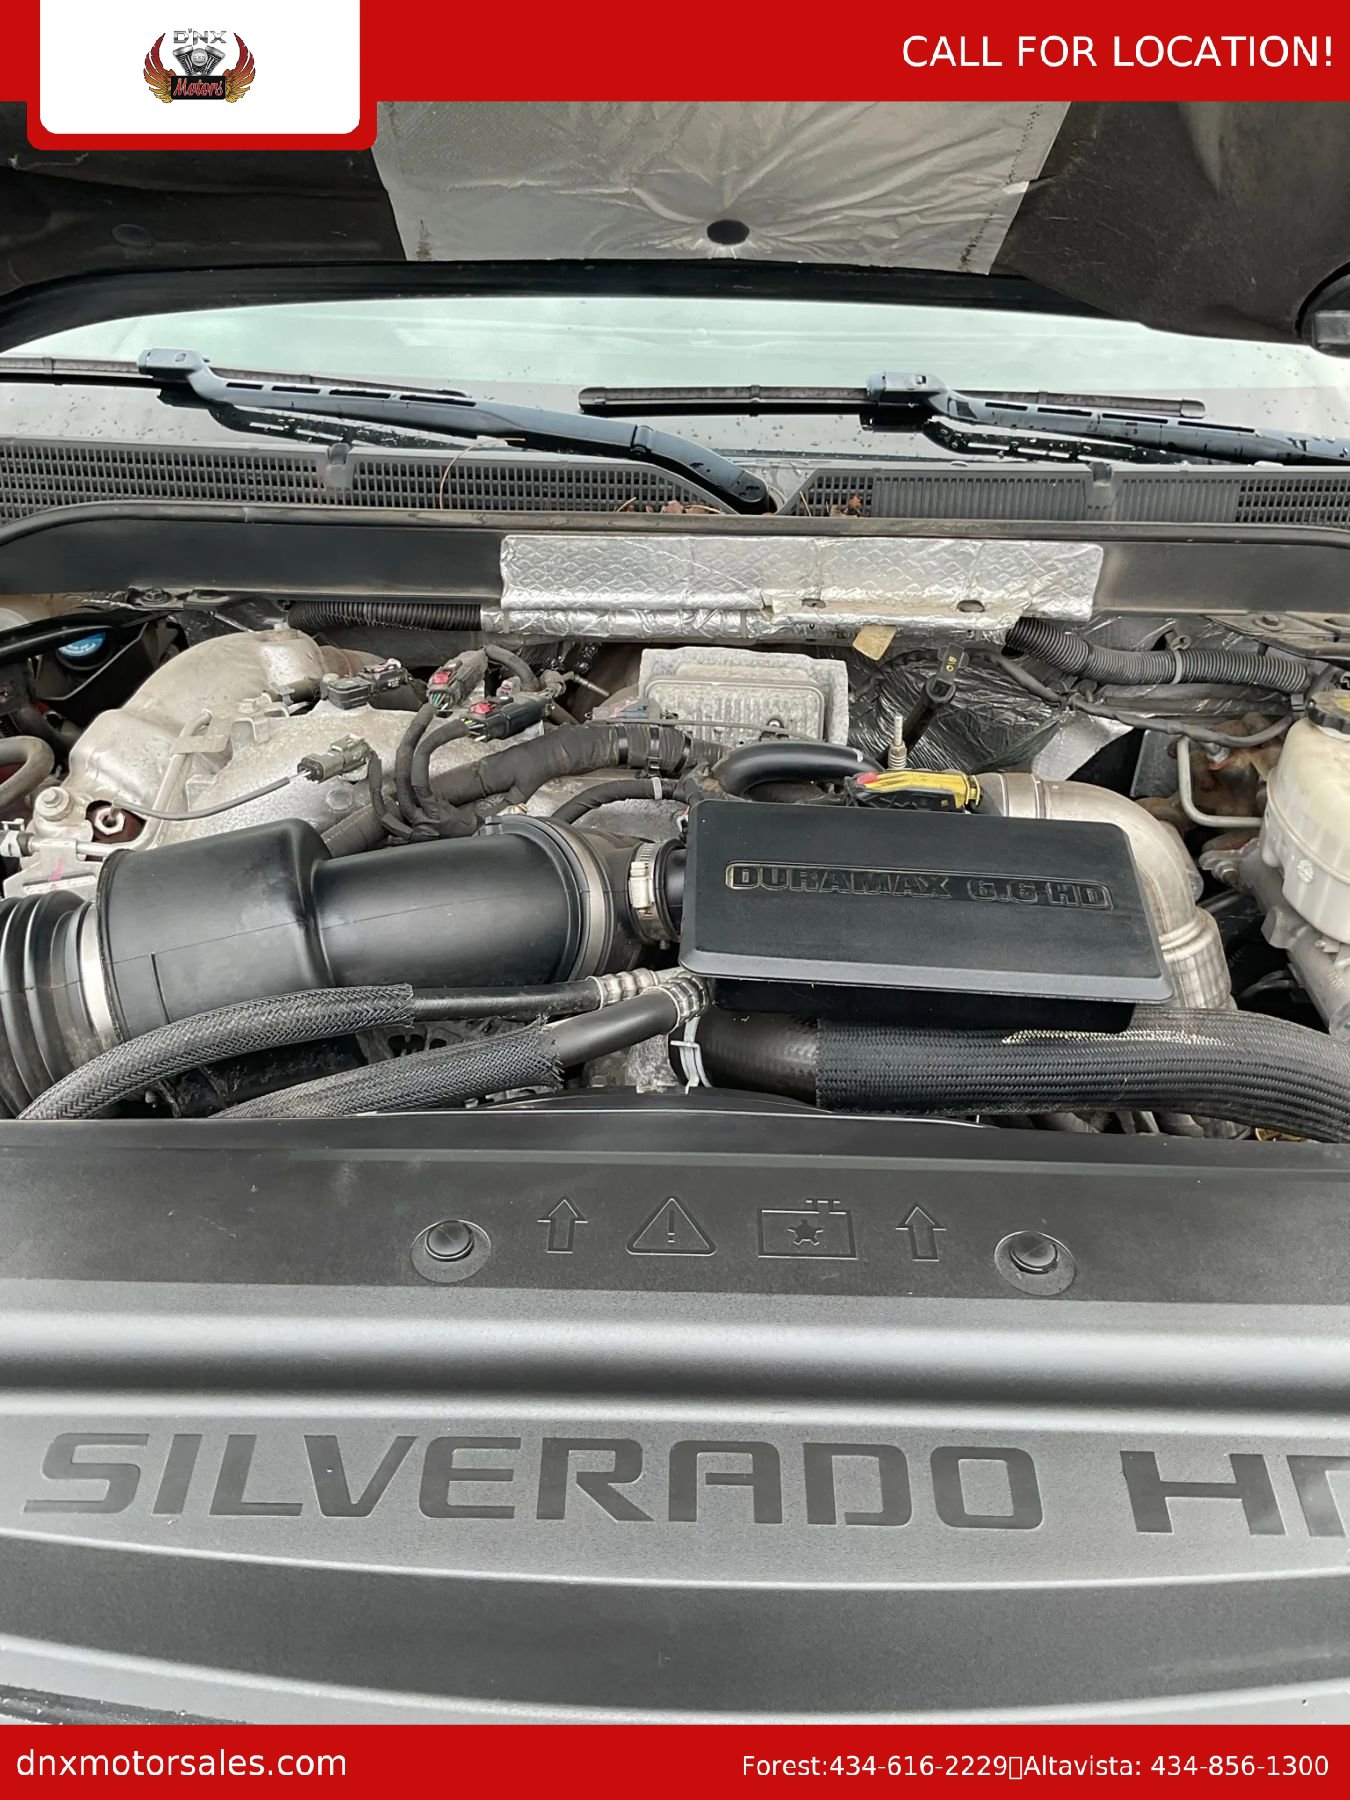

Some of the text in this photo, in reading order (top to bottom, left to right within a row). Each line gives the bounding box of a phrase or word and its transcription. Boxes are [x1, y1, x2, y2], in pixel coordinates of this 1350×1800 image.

[731, 864, 951, 899] DURAMAX
[1045, 881, 1109, 910] HD
[23, 1432, 1044, 1529] SILVERADO
